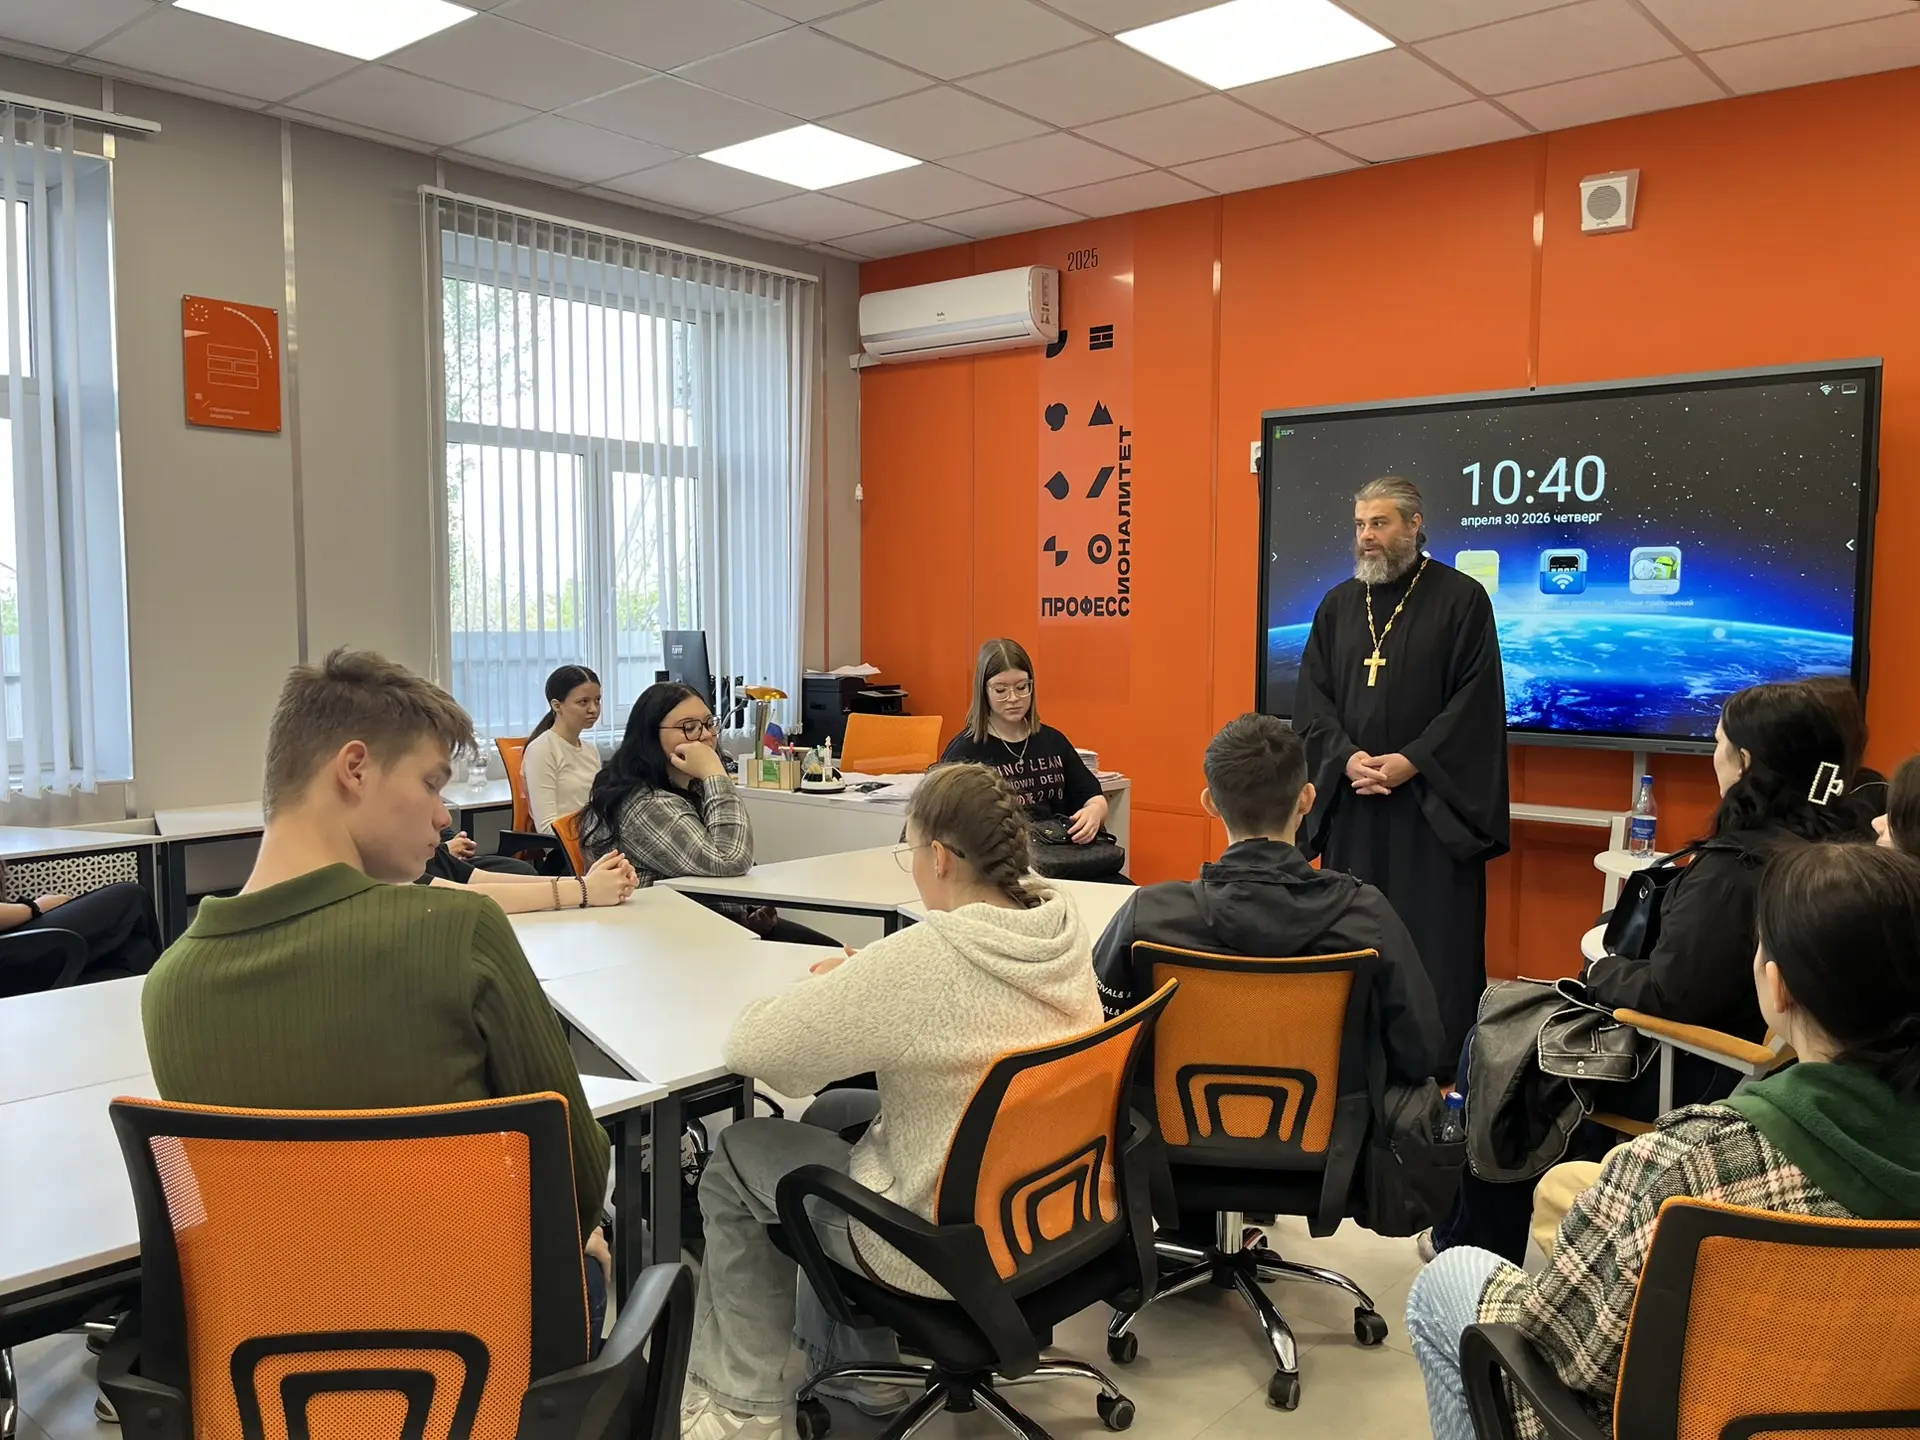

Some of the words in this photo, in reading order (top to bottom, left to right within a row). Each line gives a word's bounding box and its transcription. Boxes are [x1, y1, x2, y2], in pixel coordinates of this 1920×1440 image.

[1067, 248, 1098, 272] 2025
[1462, 455, 1606, 506] 10:40
[1460, 515, 1502, 528] апреля
[1504, 514, 1519, 525] 30
[1521, 513, 1551, 525] 2026
[1553, 511, 1603, 525] четверг
[1041, 596, 1130, 618] ПРОФЕСС
